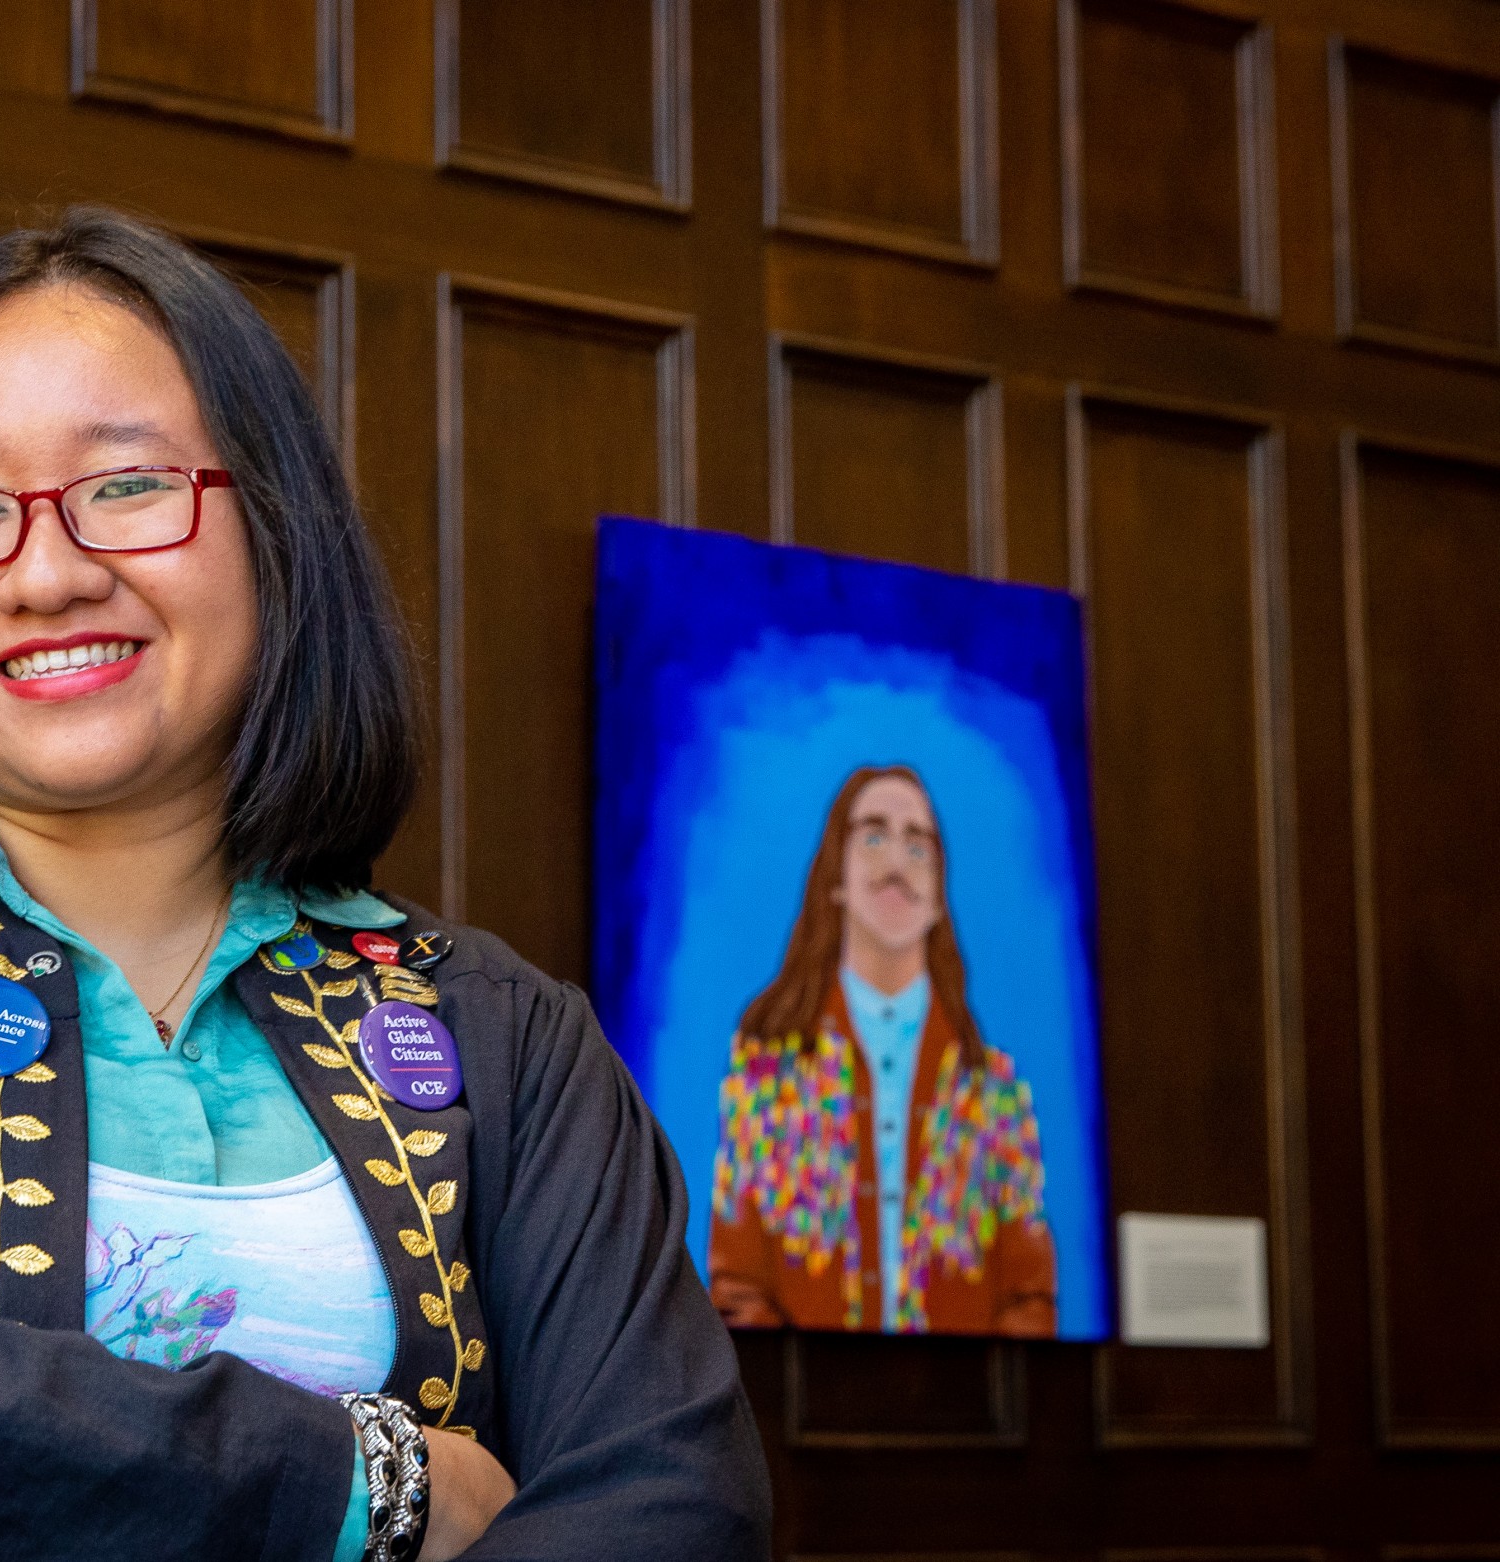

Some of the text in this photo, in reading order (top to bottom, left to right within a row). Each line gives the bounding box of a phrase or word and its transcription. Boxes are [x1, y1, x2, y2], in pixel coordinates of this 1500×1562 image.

[383, 1014, 429, 1029] Active
[387, 1030, 436, 1045] Global
[391, 1047, 444, 1061] Citizen
[411, 1081, 447, 1095] OCE
